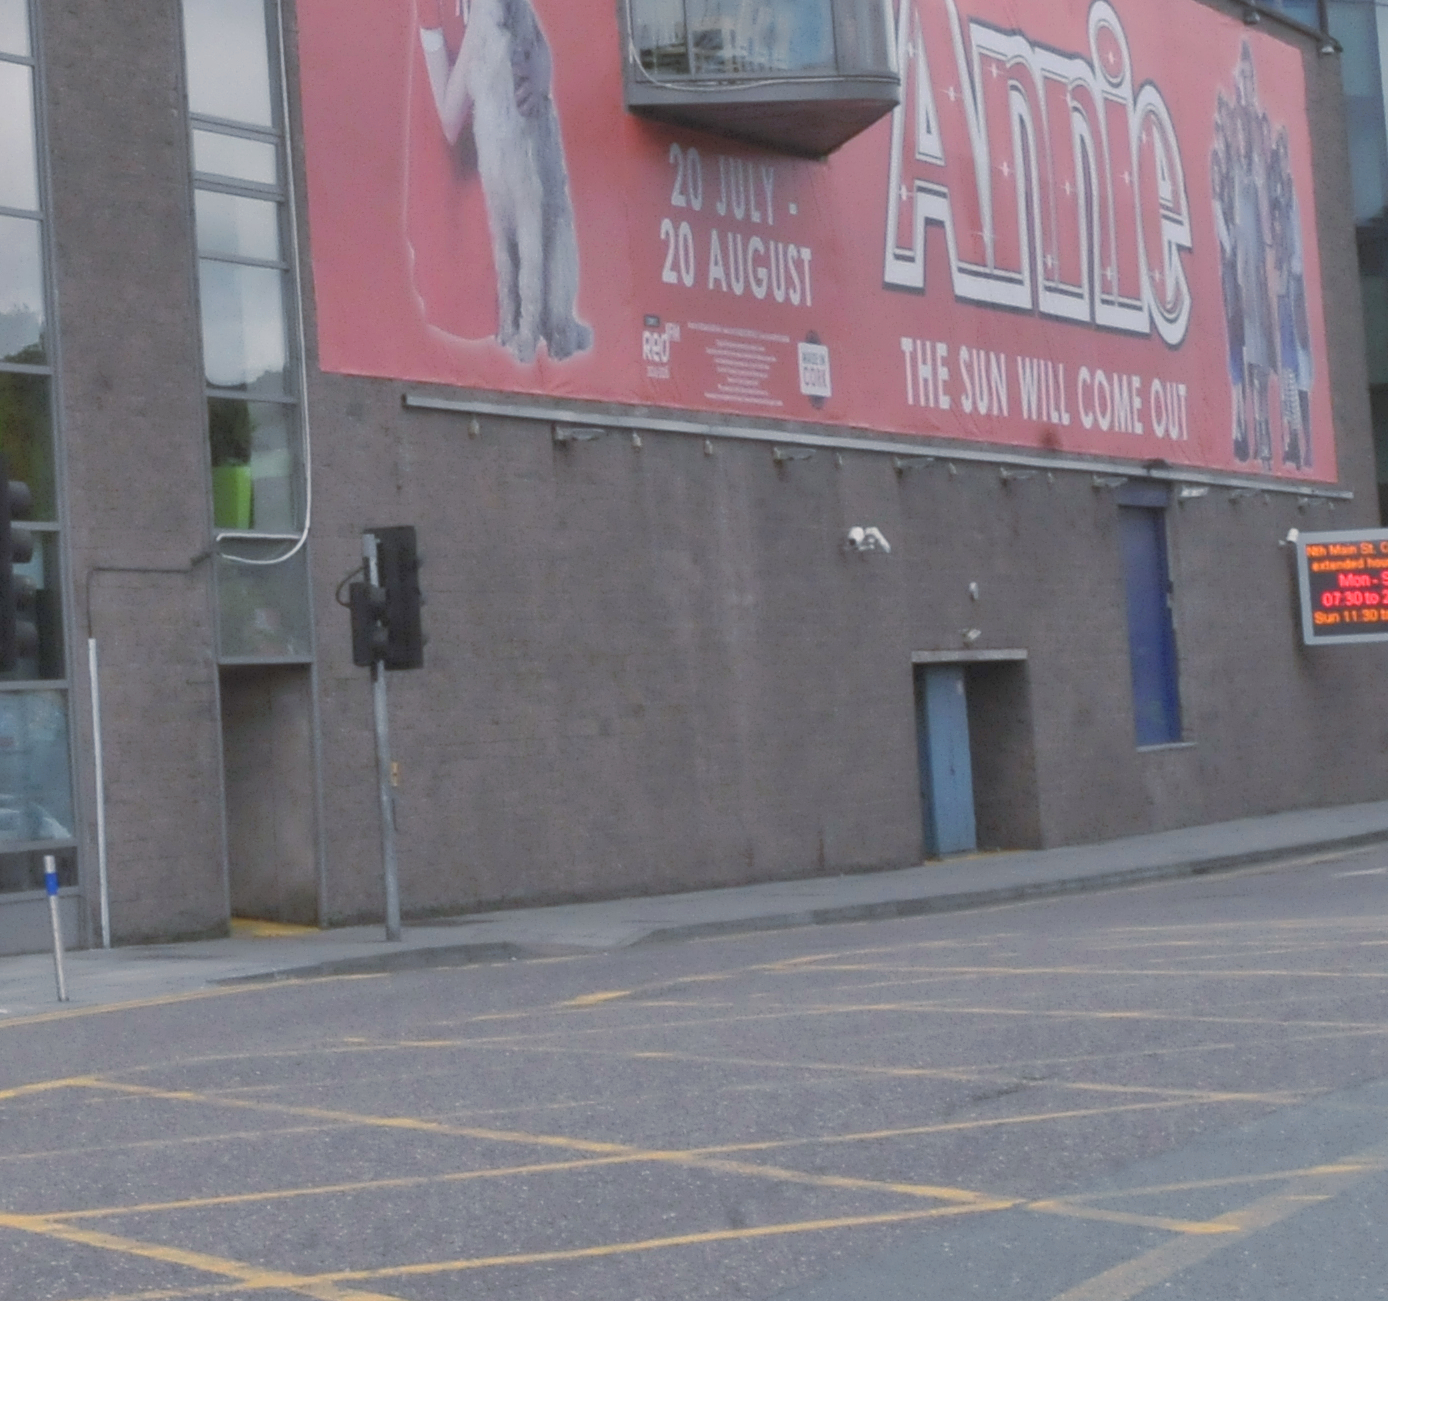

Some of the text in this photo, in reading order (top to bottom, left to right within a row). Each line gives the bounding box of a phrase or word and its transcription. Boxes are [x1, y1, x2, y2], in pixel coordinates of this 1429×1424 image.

[669, 142, 703, 211] 20
[716, 154, 775, 226] JULY
[660, 218, 812, 307] 20 AUGUST
[802, 366, 829, 389] CORK
[901, 337, 1189, 441] THE SUN WILL COME OUT
[1328, 544, 1357, 556] Main
[1311, 557, 1365, 572] extended
[1338, 573, 1371, 588] Mon
[1364, 591, 1380, 605] to
[1313, 610, 1340, 625] Sun
